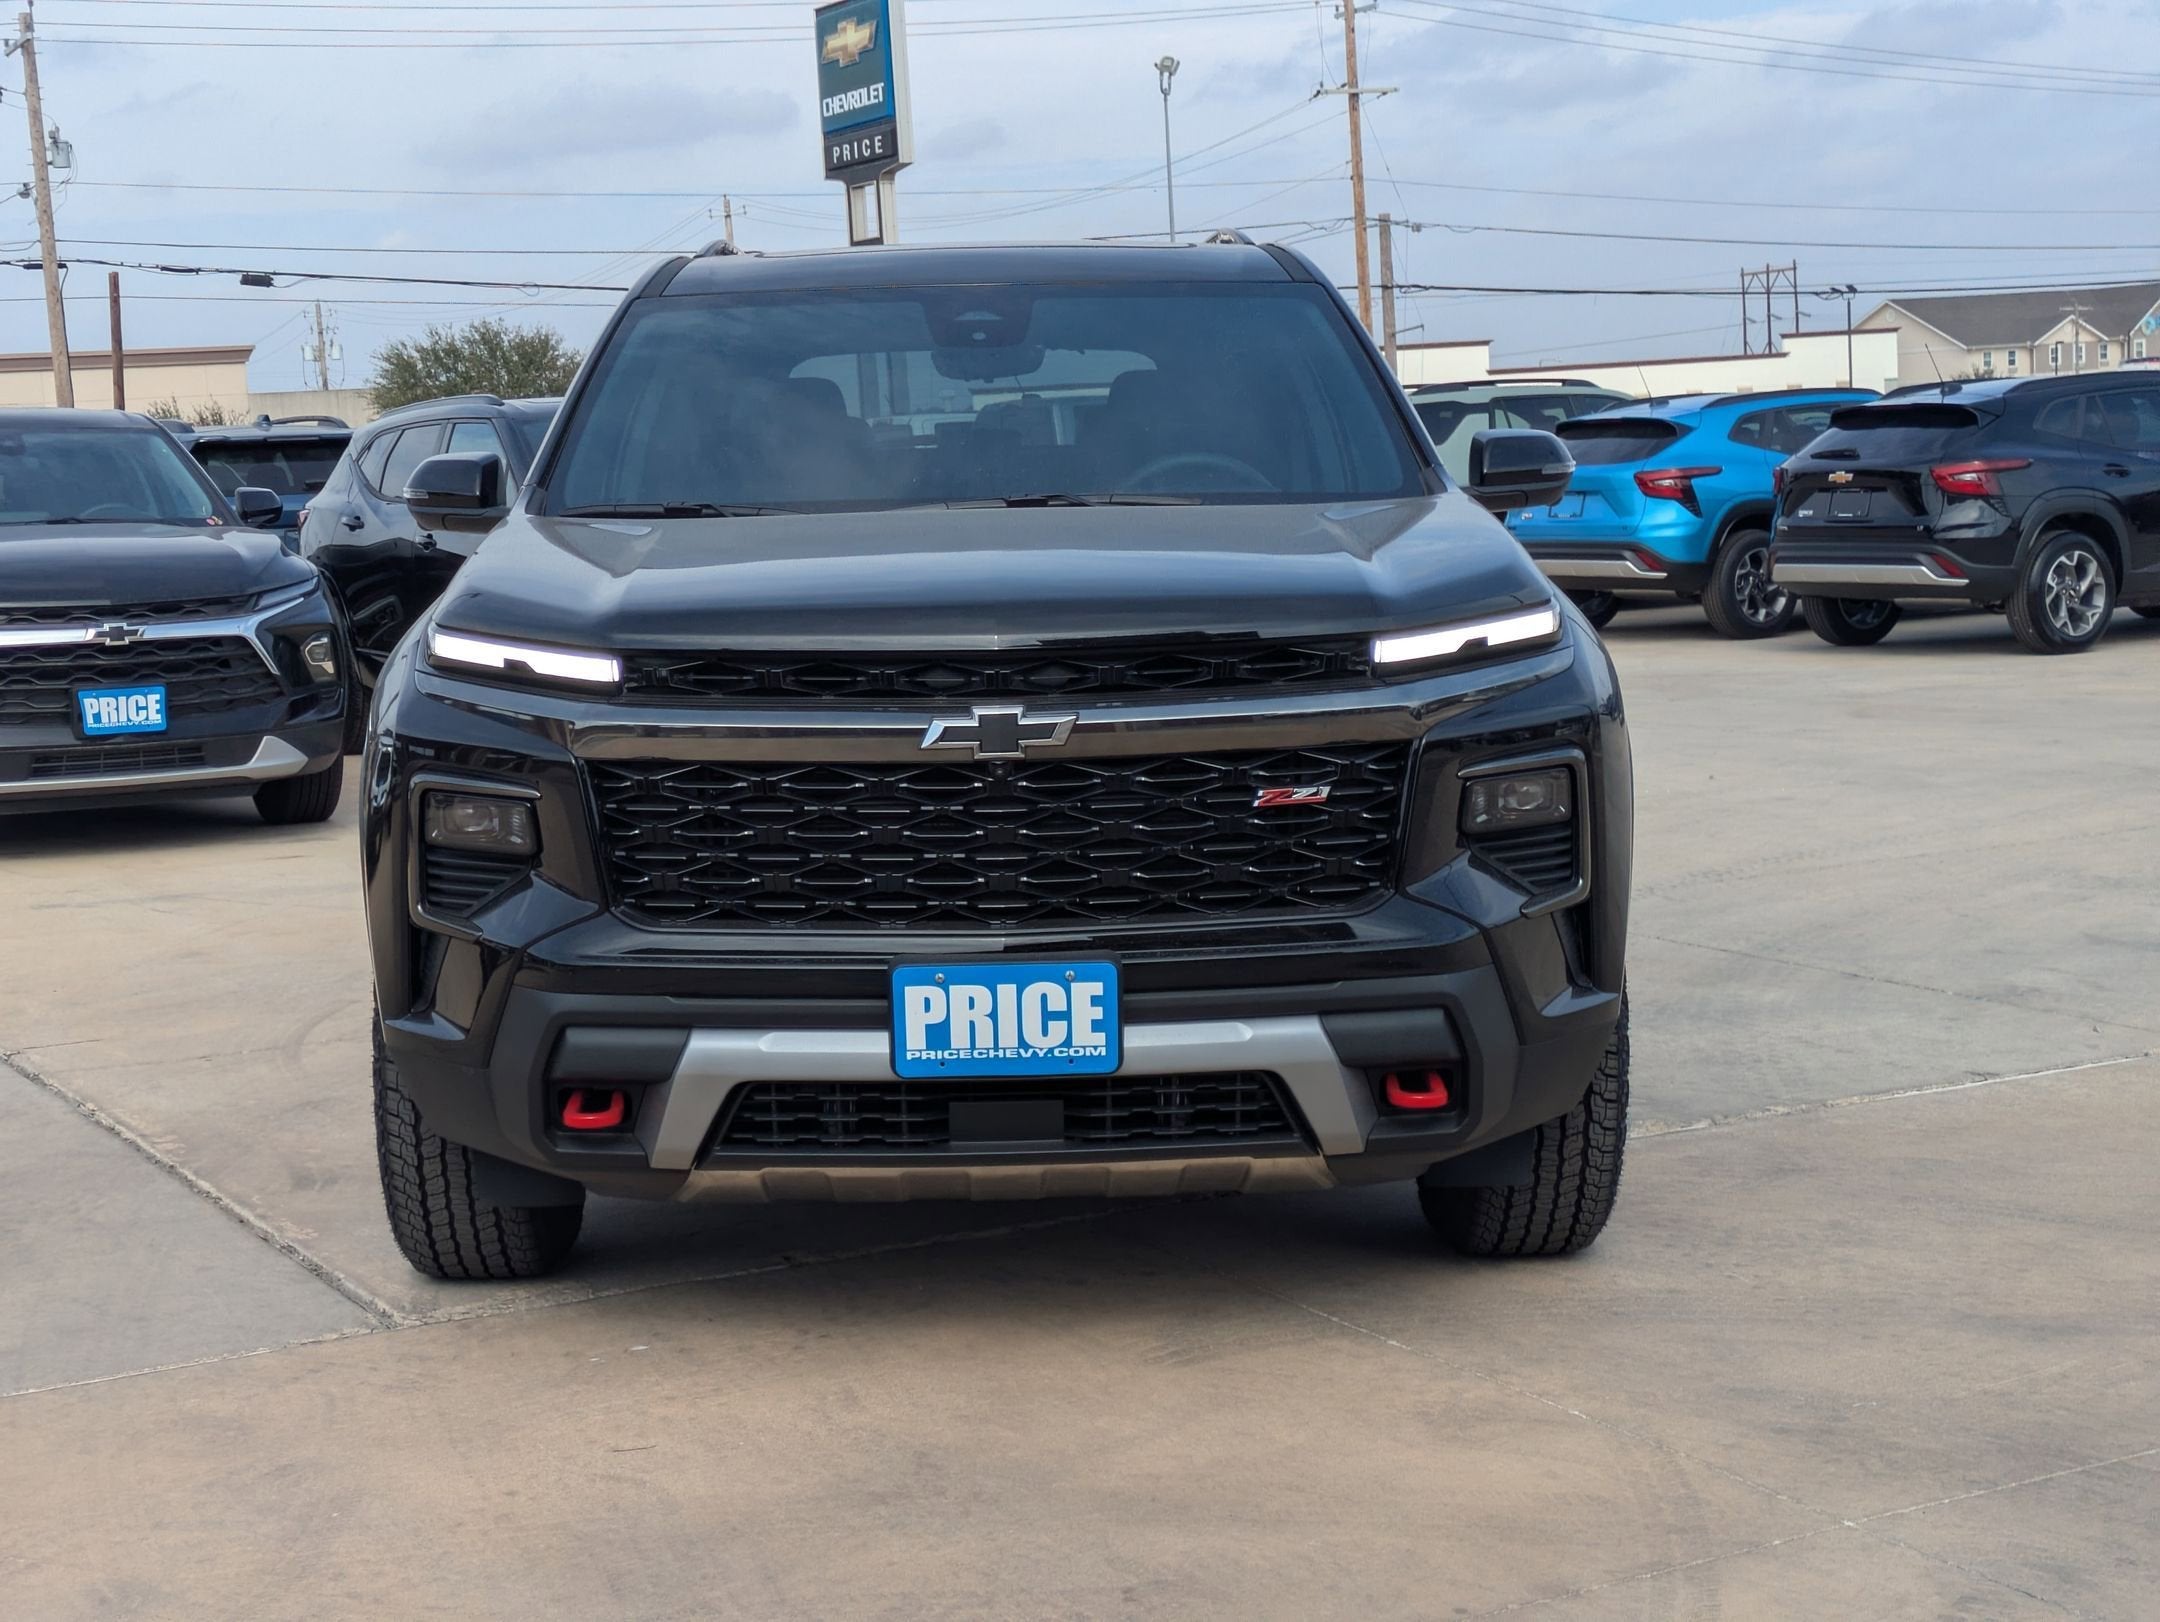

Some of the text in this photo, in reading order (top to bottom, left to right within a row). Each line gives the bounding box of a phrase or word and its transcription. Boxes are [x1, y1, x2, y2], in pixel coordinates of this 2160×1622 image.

[822, 82, 884, 117] CHEVROLET
[833, 135, 883, 164] PRICE
[83, 694, 161, 724] PRICE
[904, 981, 1106, 1050] PRICE
[906, 1047, 1106, 1060] PRICECHEVY.COM
